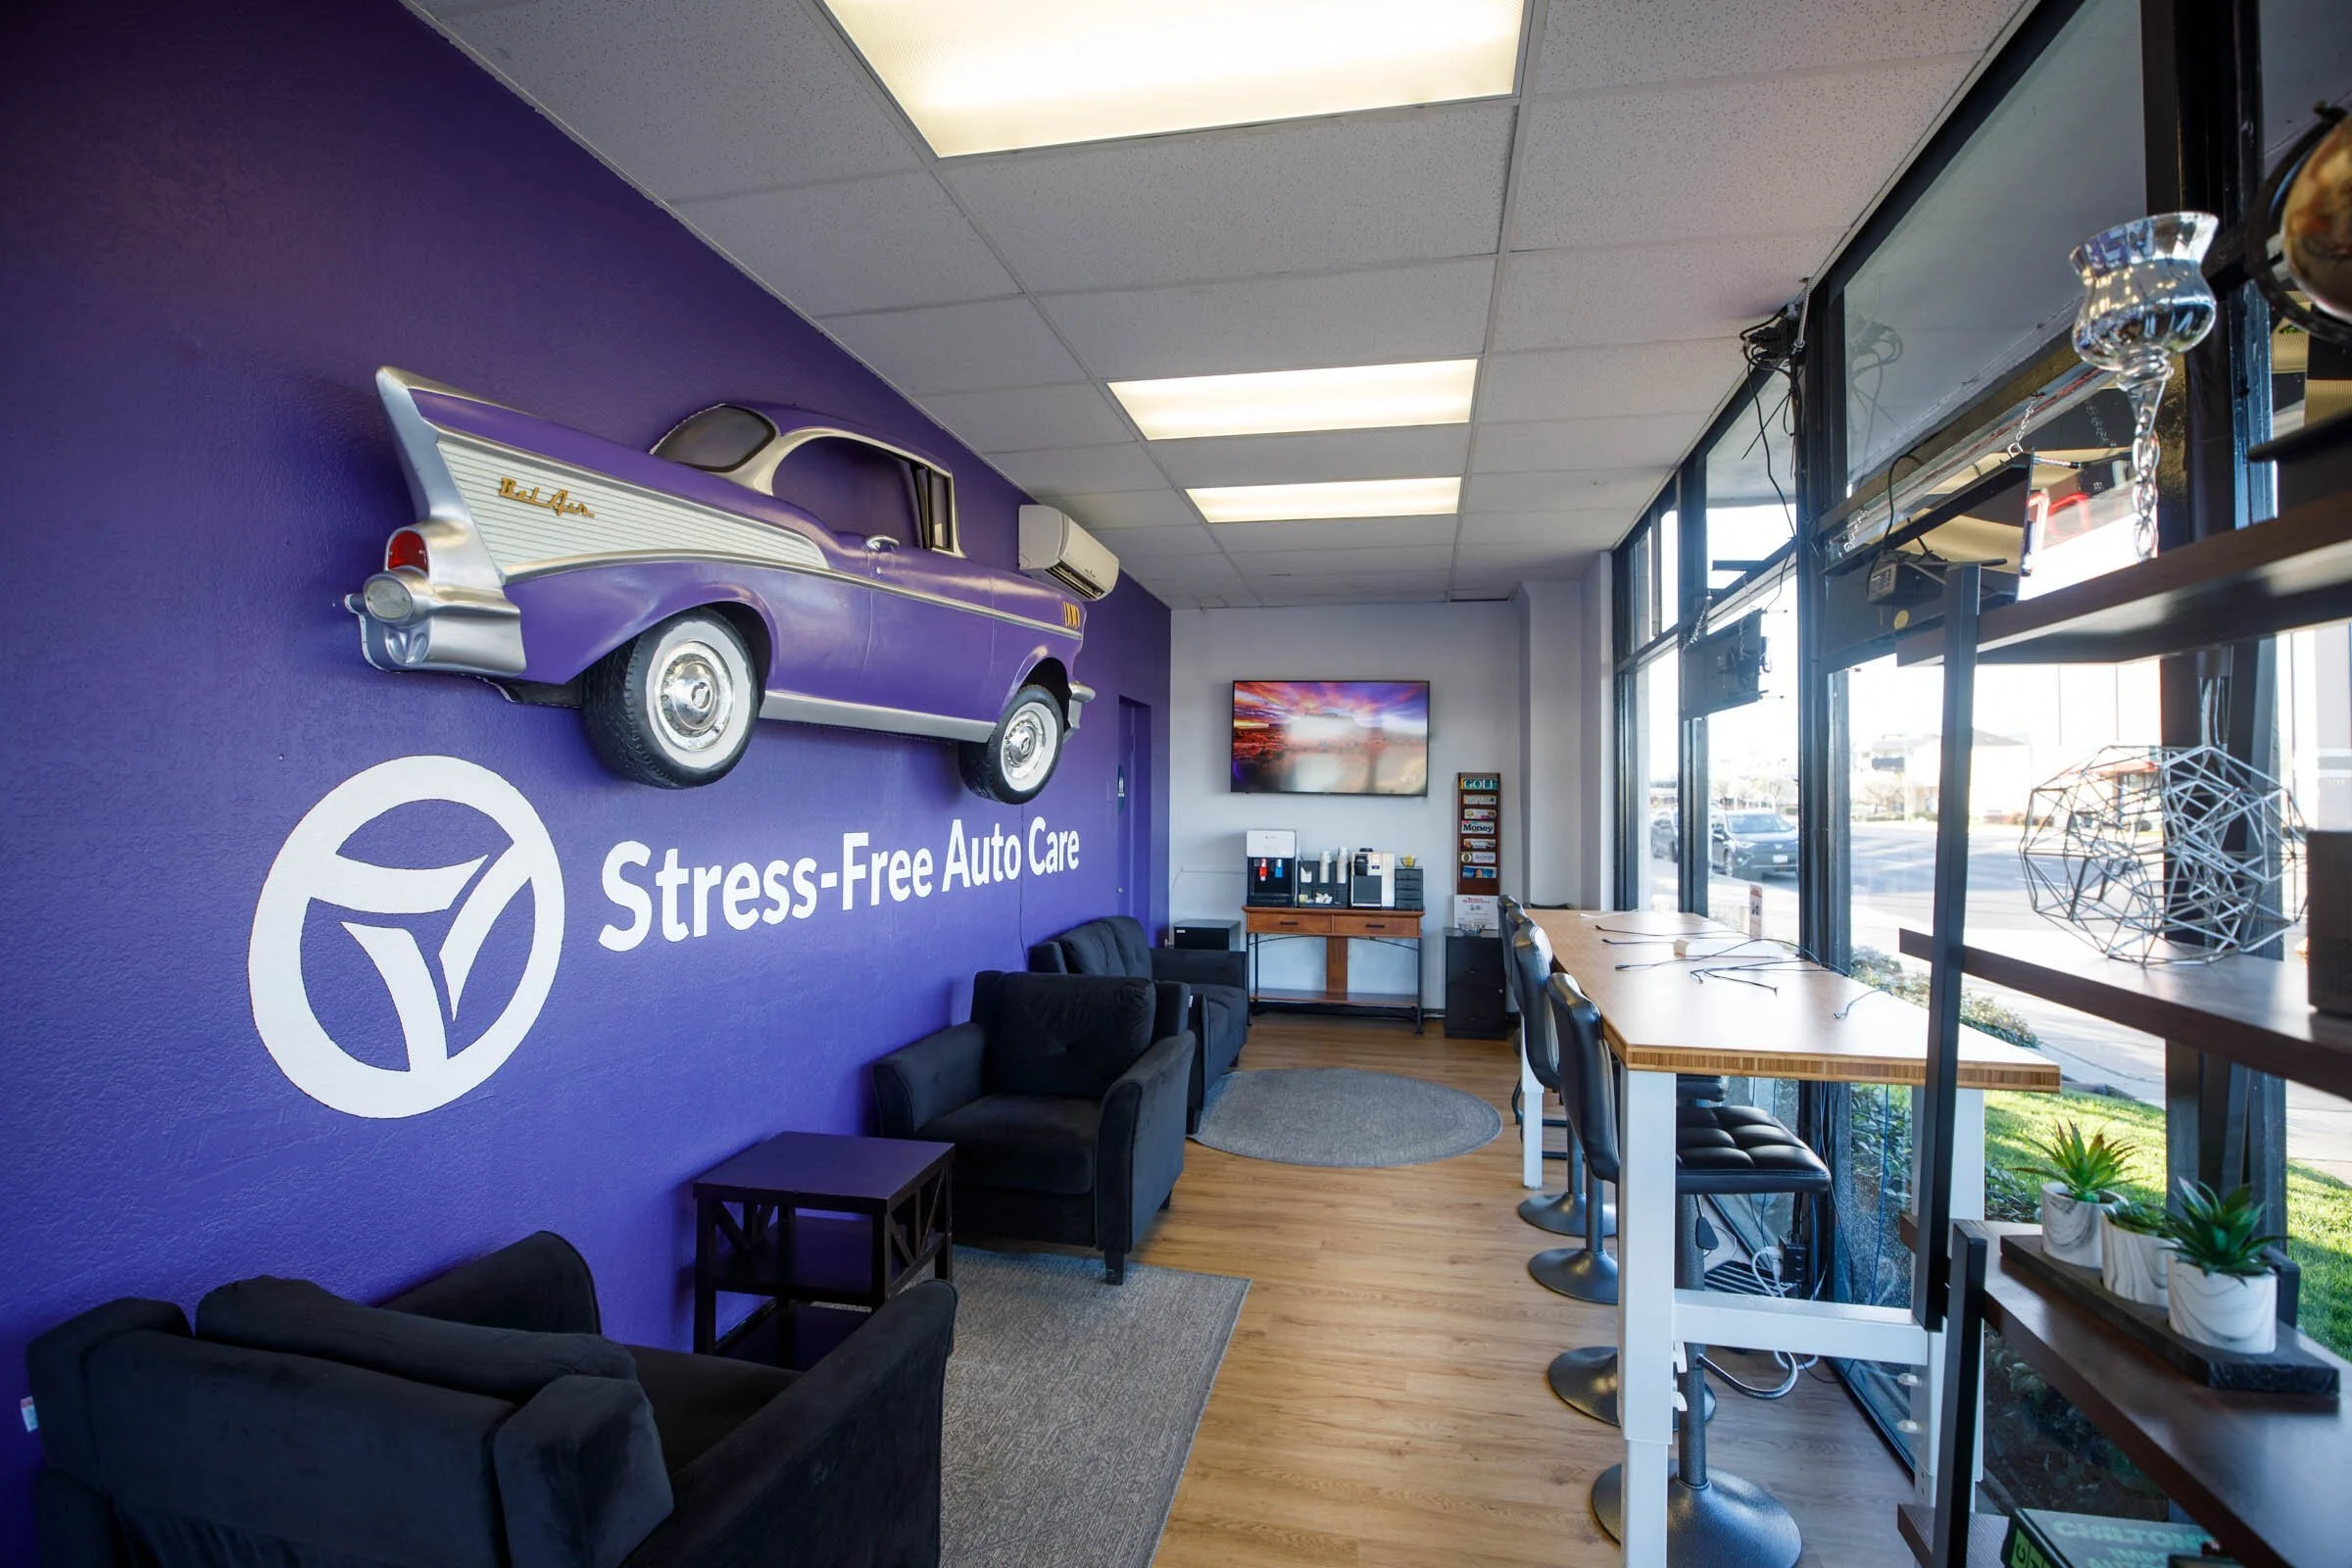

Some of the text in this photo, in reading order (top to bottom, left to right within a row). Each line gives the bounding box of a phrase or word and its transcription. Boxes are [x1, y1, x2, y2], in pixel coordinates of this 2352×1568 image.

[498, 476, 595, 517] Bel Air
[1462, 824, 1494, 833] Money
[598, 816, 1079, 952] Stress-Free Auto Care
